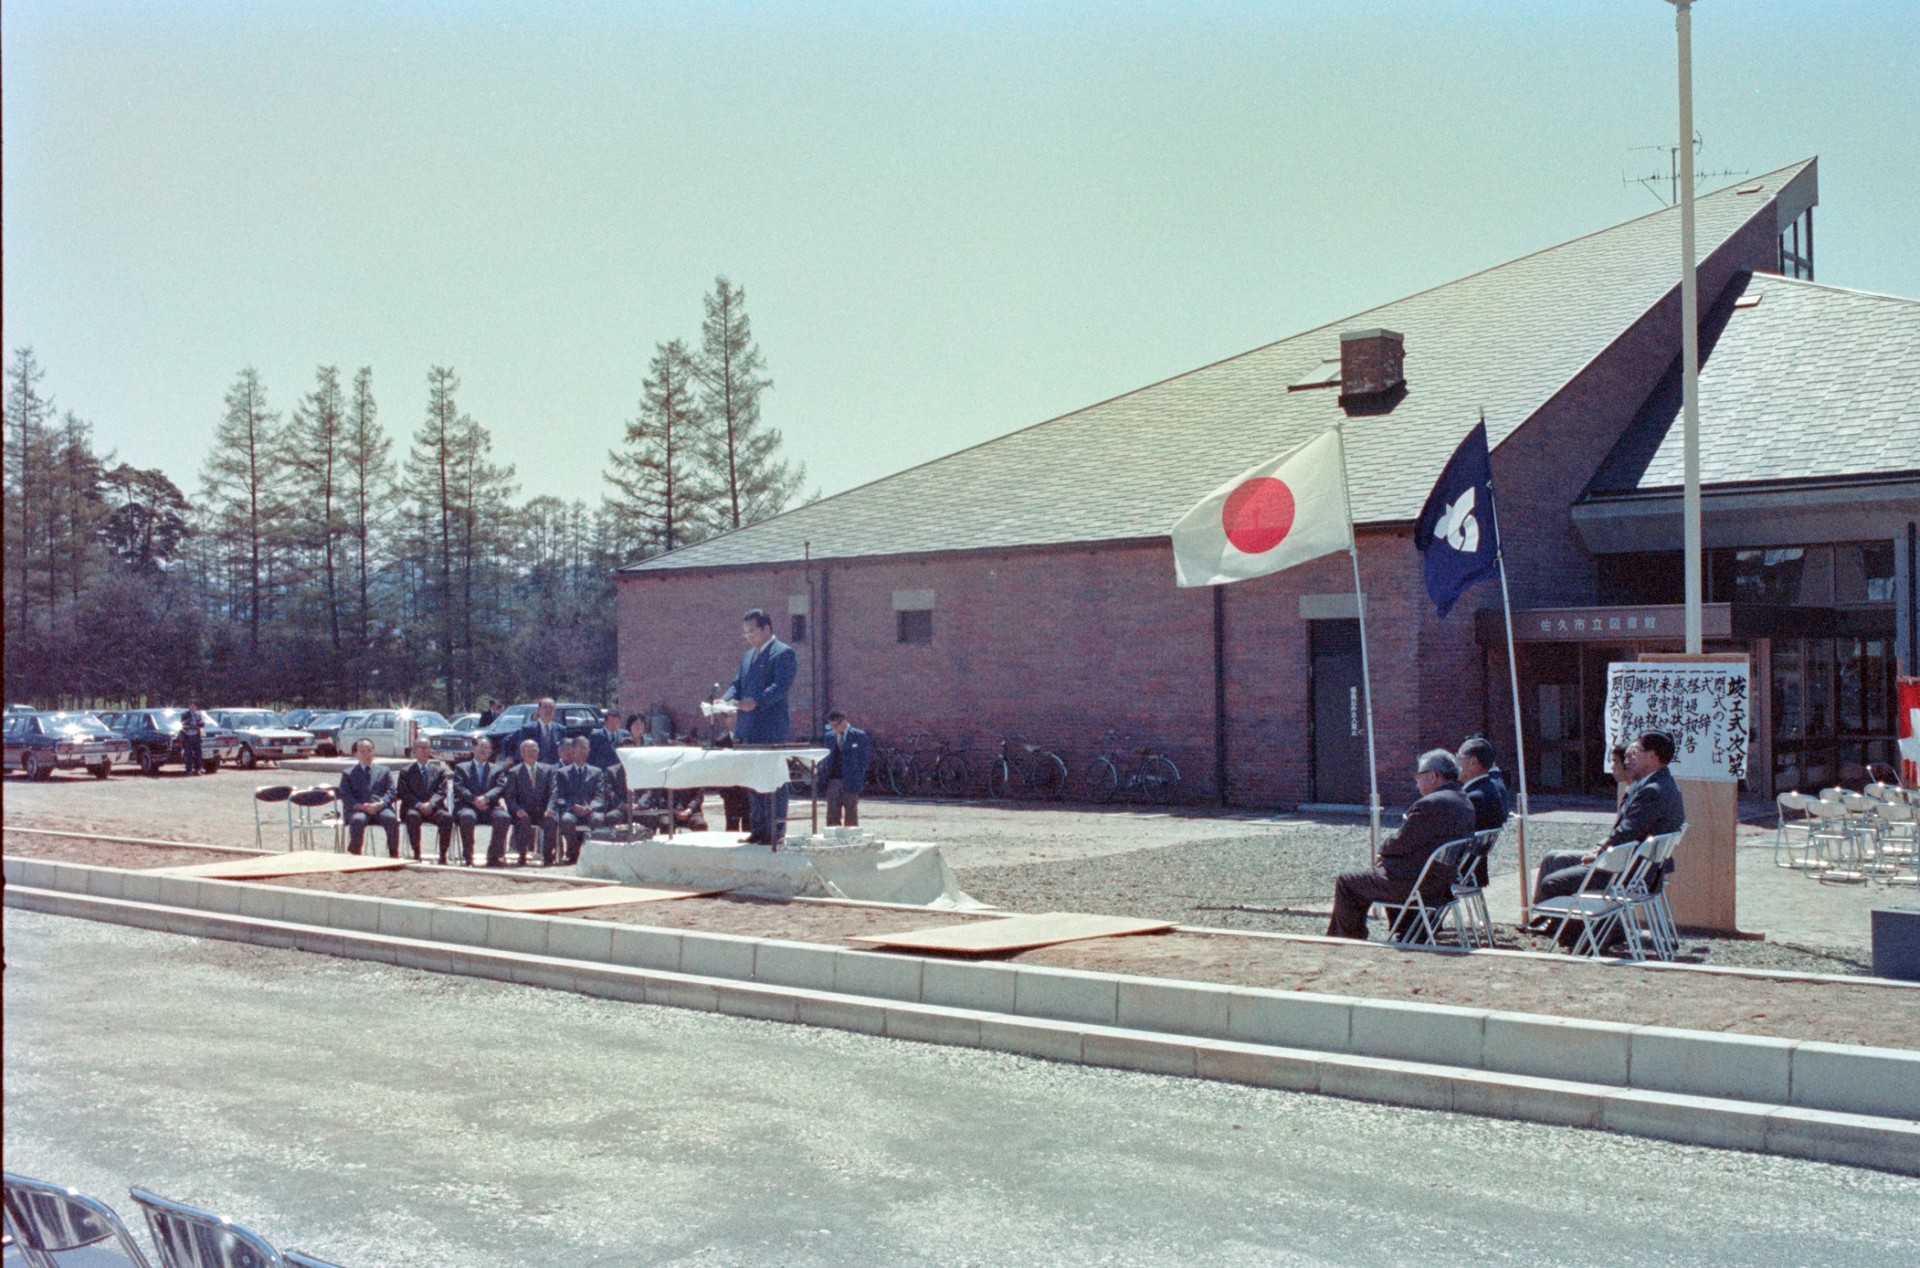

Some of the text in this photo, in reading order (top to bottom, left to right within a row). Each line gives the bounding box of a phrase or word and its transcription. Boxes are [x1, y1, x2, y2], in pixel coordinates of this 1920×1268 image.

[1540, 616, 1656, 631] 佐久市立図書館
[1727, 675, 1747, 777] 竣工式次第
